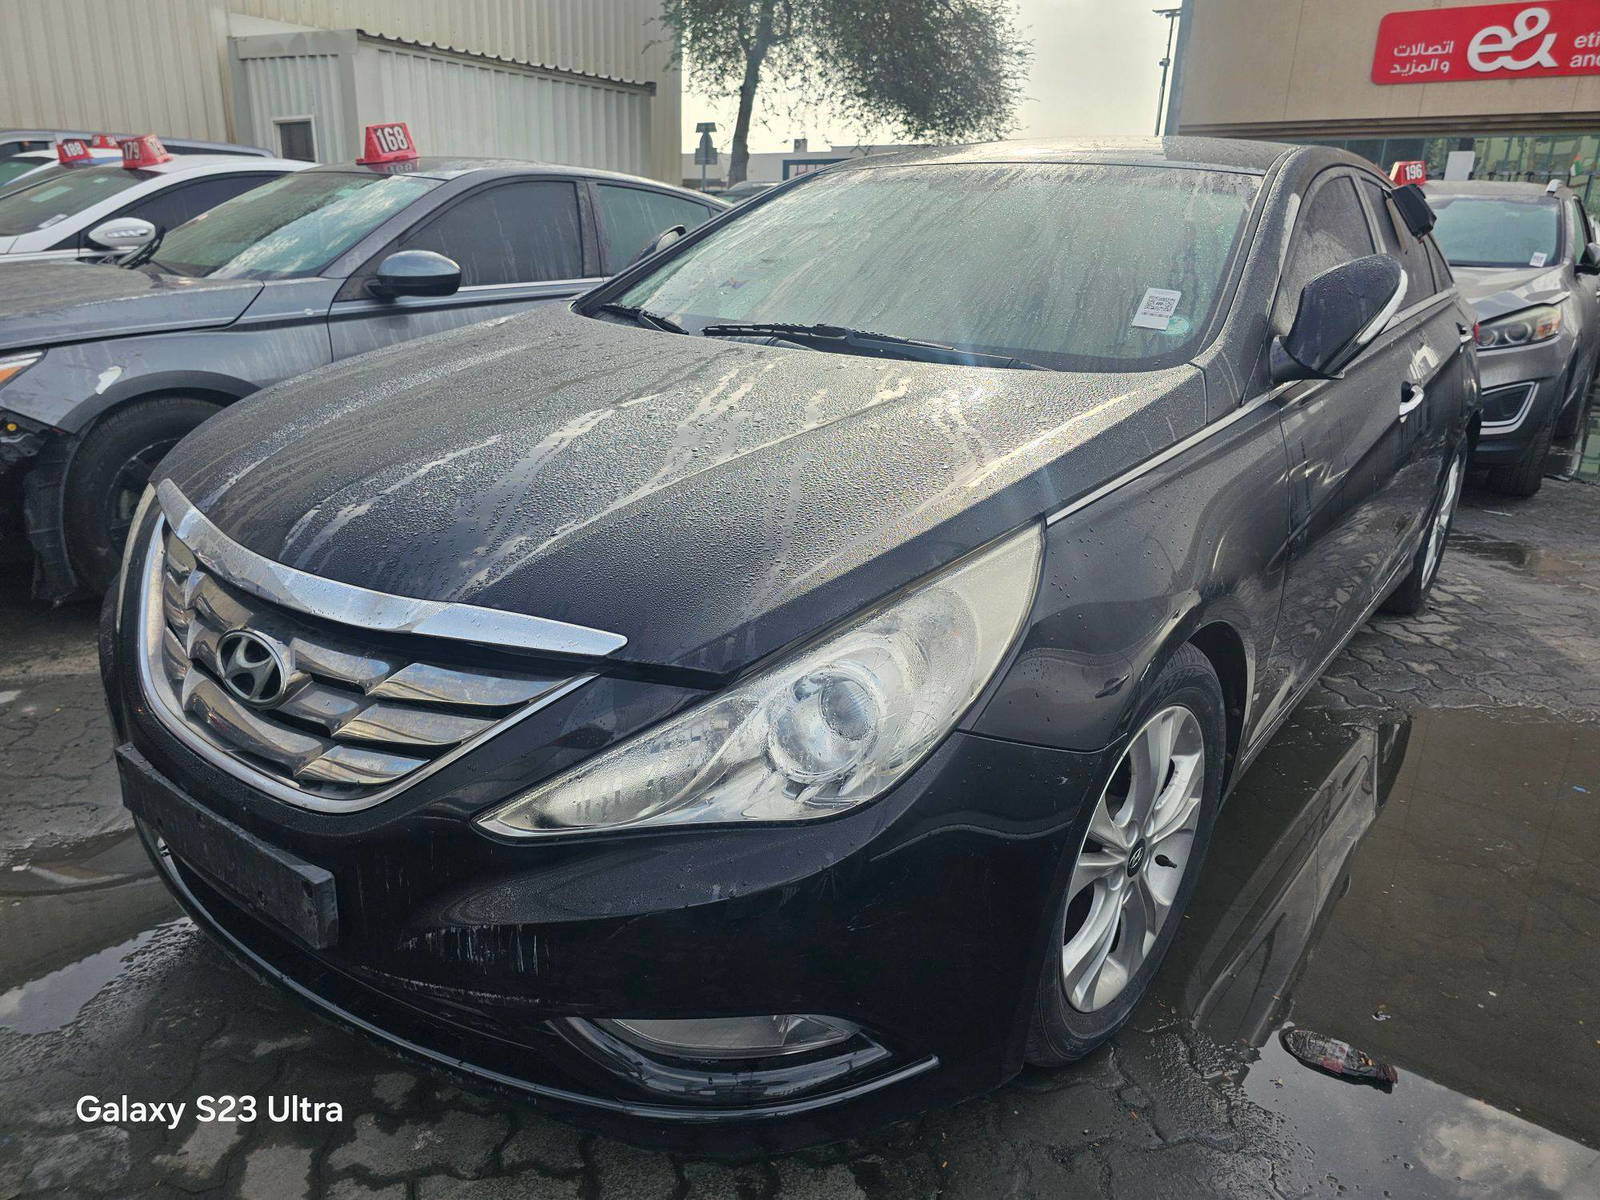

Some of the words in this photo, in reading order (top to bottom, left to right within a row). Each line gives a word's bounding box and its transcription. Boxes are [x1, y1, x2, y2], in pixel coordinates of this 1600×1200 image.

[1393, 40, 1454, 57] اتصالات
[1467, 7, 1558, 73] e&
[376, 126, 409, 153] 168
[124, 142, 140, 160] 179
[1405, 164, 1423, 180] 196
